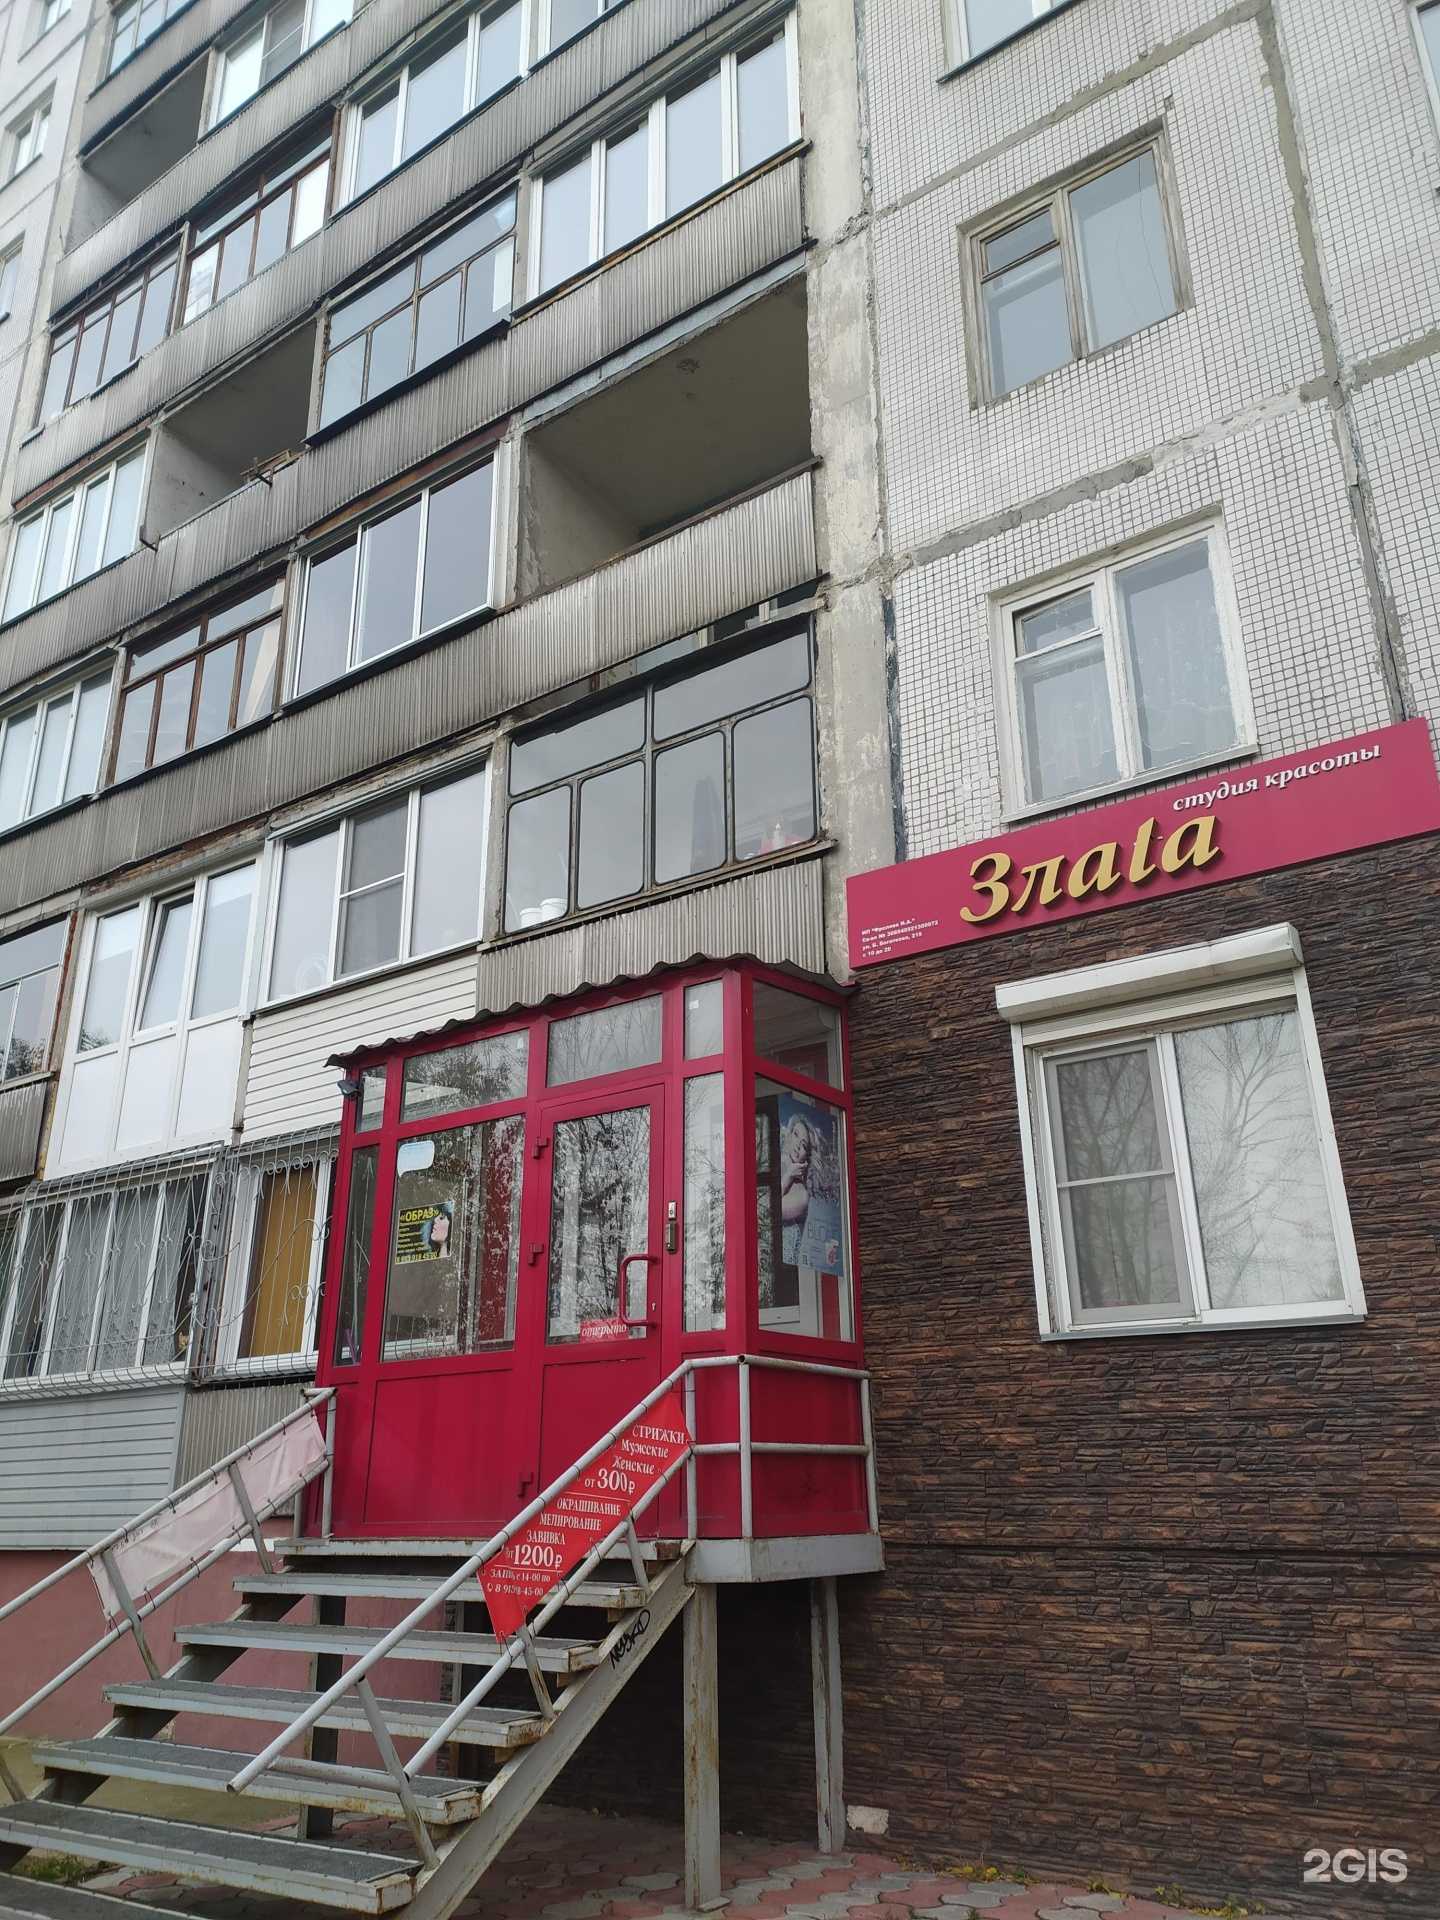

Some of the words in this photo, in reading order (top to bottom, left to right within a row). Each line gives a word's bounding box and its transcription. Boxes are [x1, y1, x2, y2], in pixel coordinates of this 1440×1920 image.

[1172, 776, 1260, 813] студия
[1265, 743, 1383, 791] красоты
[632, 1423, 686, 1444] СТРИЖКИ
[621, 1438, 669, 1458] Мужские
[612, 1455, 655, 1475] Женские
[584, 1477, 595, 1488] от
[556, 1498, 622, 1515] ОКРАШИВАНИЕ
[540, 1513, 602, 1531] МЕЛИРОВАНИЕ
[526, 1529, 566, 1545] ЗАВИВКА
